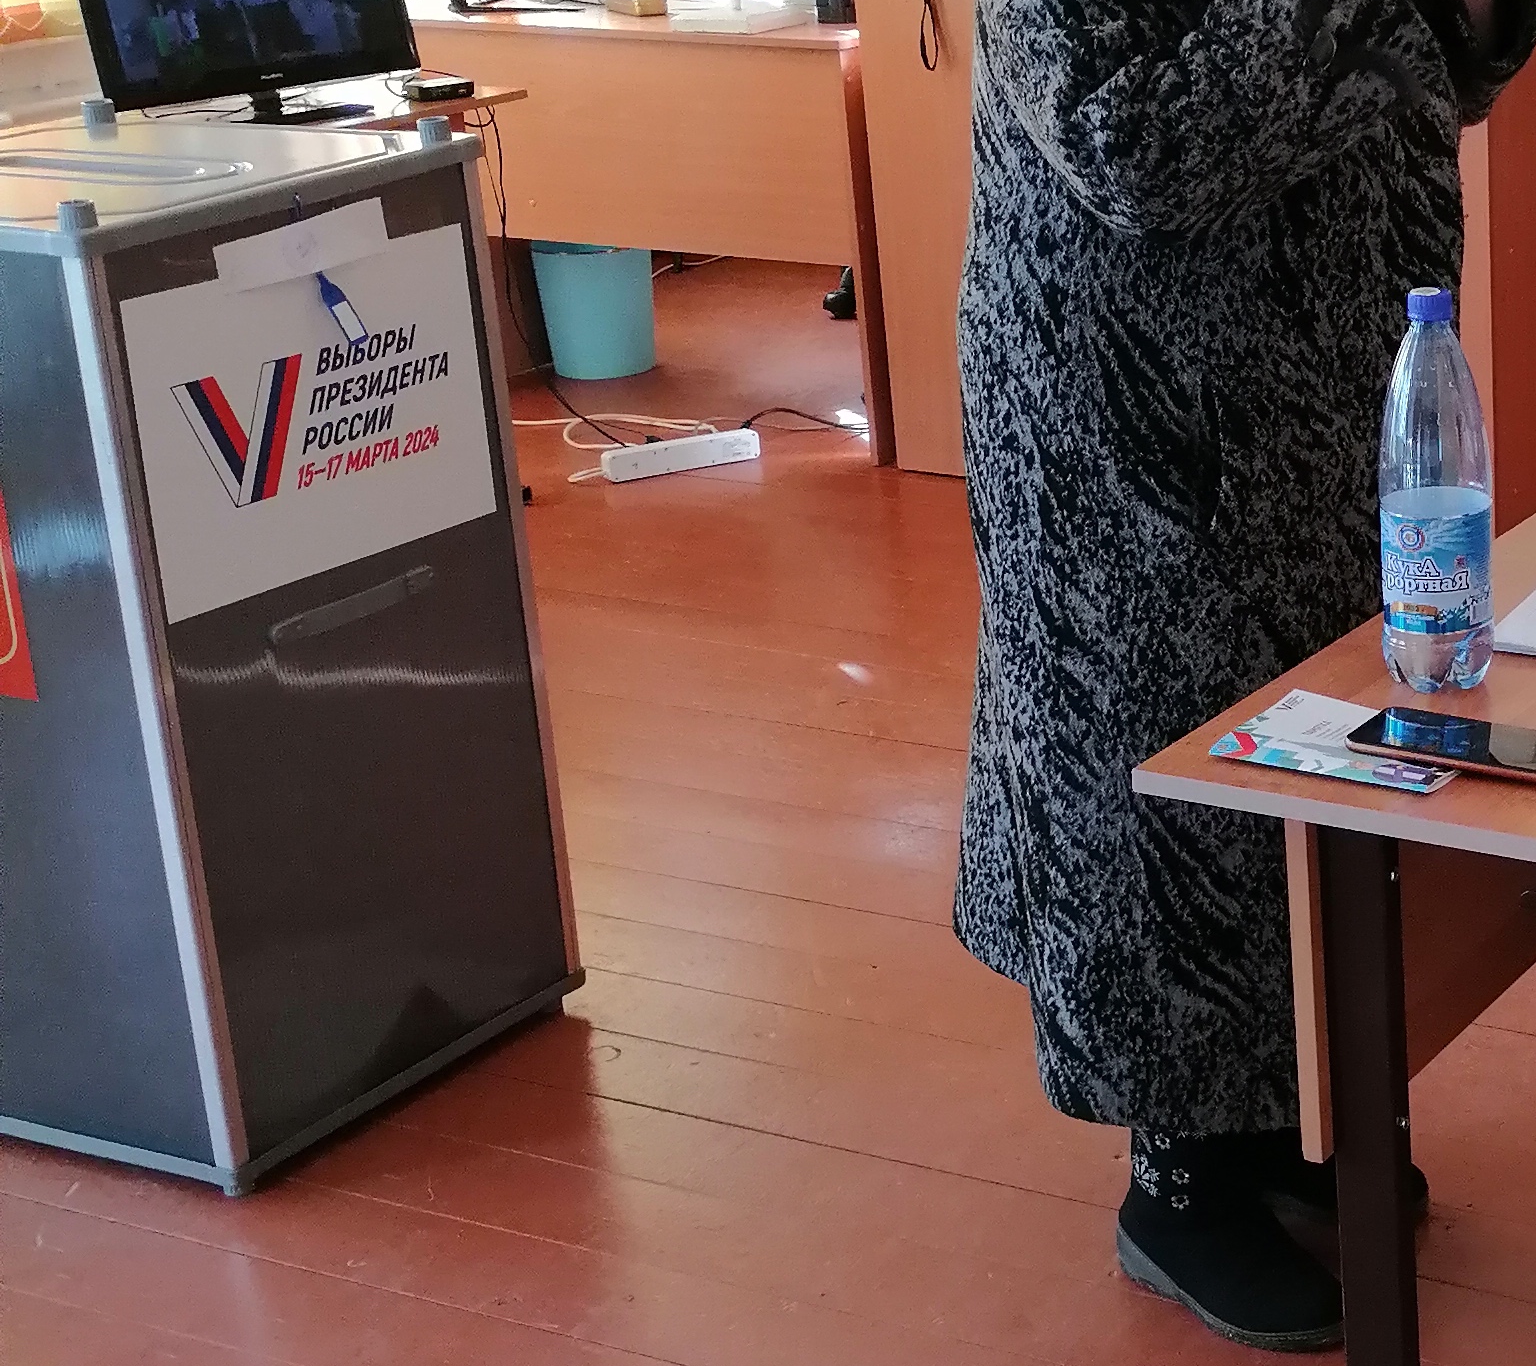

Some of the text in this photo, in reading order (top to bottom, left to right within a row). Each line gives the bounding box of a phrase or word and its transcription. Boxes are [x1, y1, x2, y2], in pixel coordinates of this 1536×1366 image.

[316, 324, 416, 376] ВЫБОРЫ
[309, 351, 449, 415] ПРЕЗИДЕНТА
[302, 403, 394, 455] РОССИИ
[345, 436, 399, 475] МАРТА
[402, 425, 439, 457] 2024
